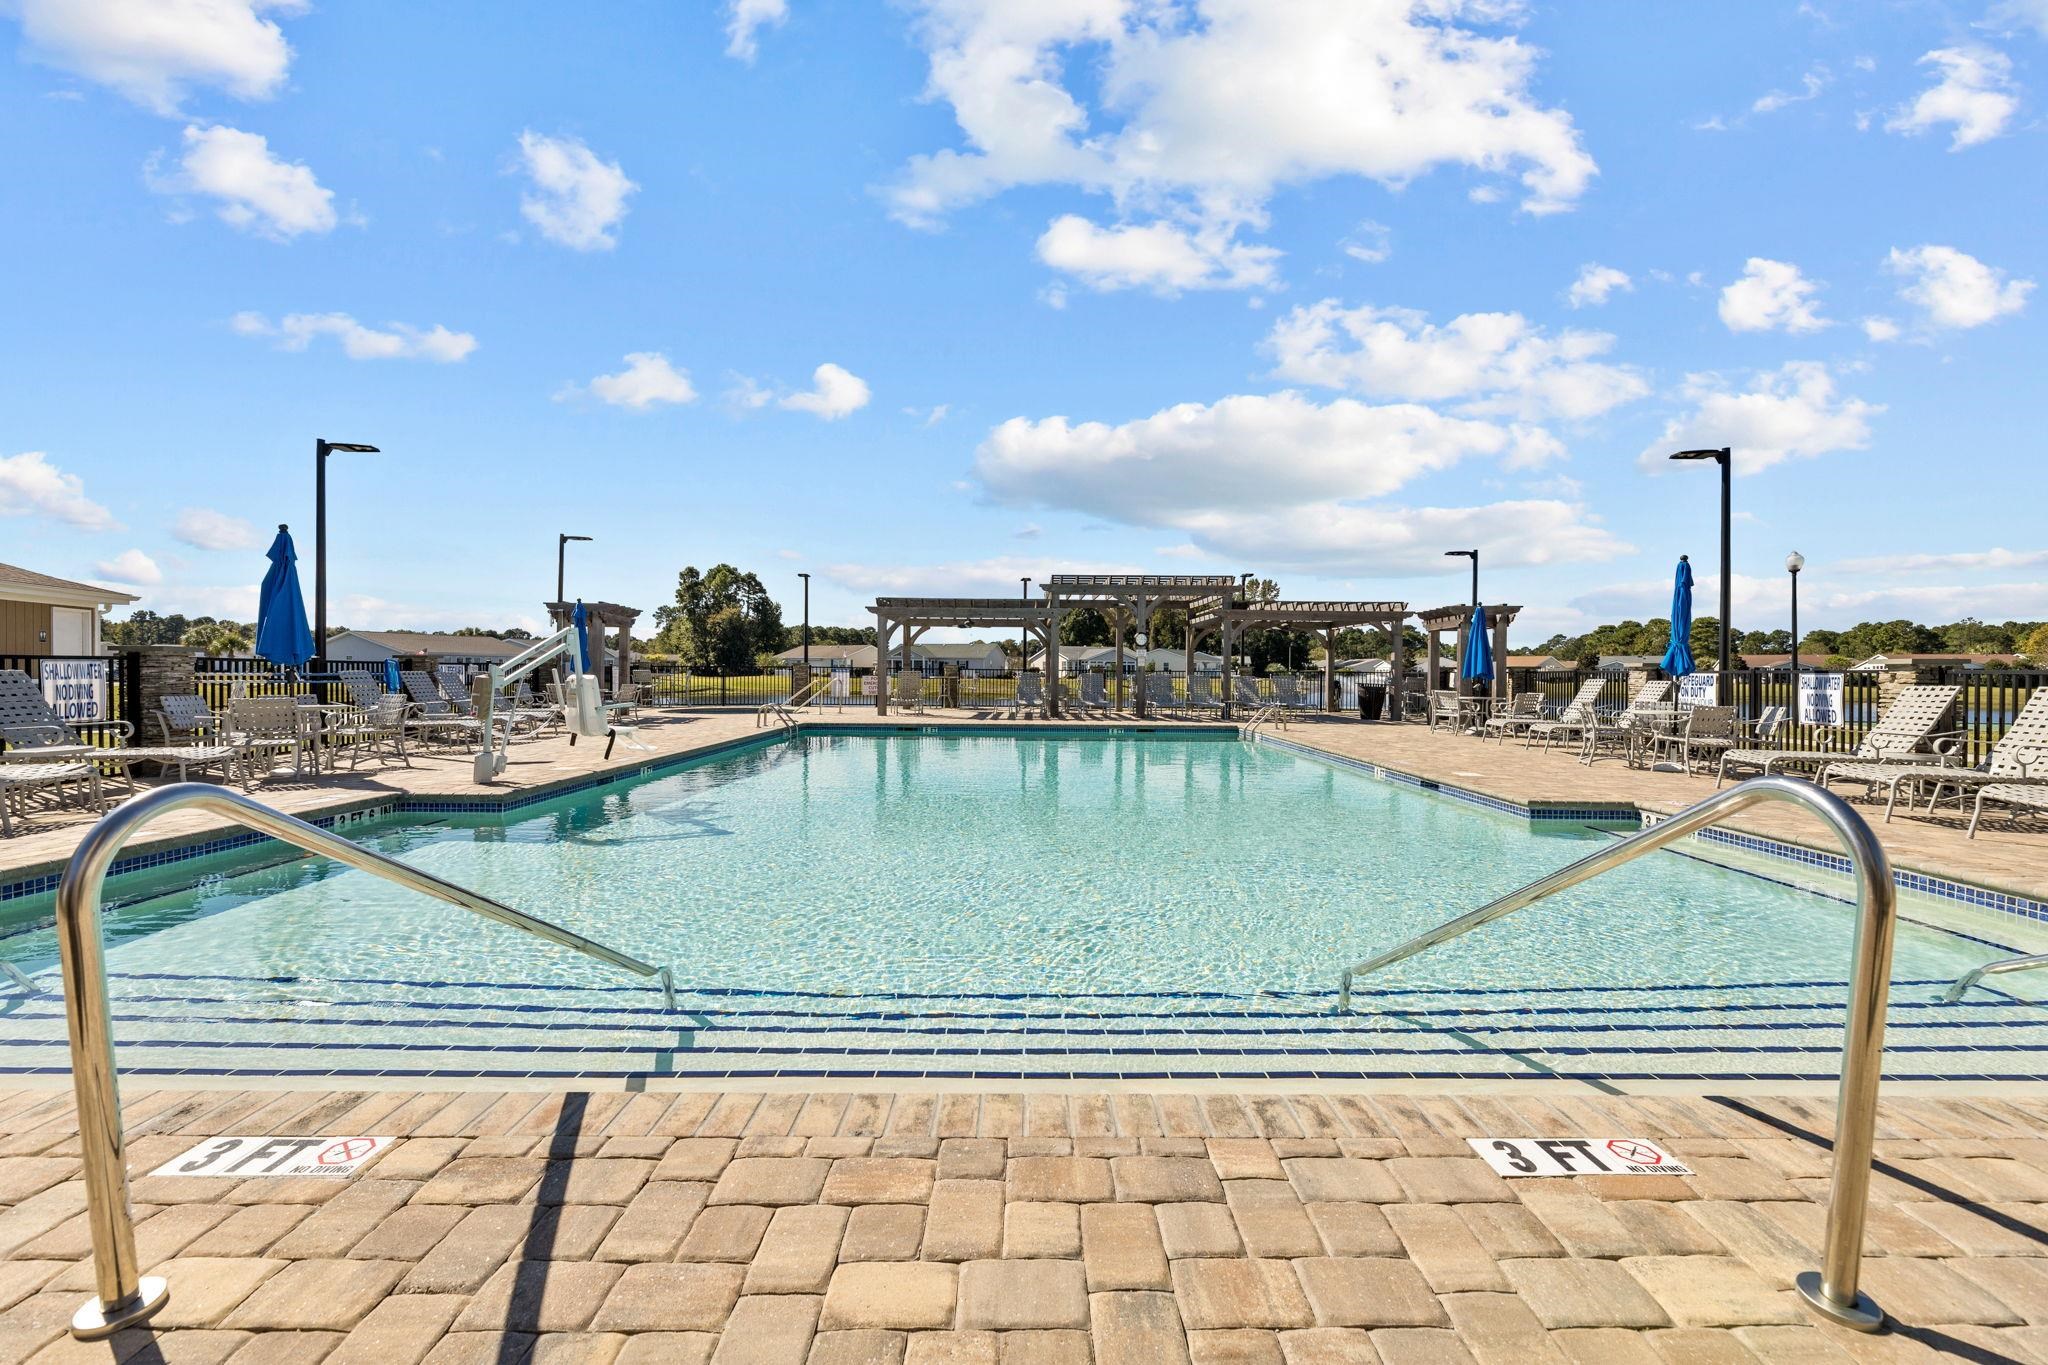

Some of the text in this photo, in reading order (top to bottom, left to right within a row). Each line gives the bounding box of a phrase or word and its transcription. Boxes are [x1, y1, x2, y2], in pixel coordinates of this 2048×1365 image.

[45, 663, 103, 680] SHALLOW WATER
[1801, 676, 1841, 690] SHALLOW WATER
[56, 683, 94, 701] NO DIVING
[1681, 686, 1707, 698] ON DUTY
[1807, 693, 1832, 708] NO DIVING
[52, 702, 98, 719] ALLOWED
[1804, 708, 1837, 723] ALLOWED
[1645, 814, 1651, 828] 3
[178, 1139, 328, 1172] 3 FT
[1492, 1140, 1613, 1173] 3 FT
[288, 1165, 355, 1174] NO DIVING
[1626, 1165, 1689, 1173] NO DIVING
